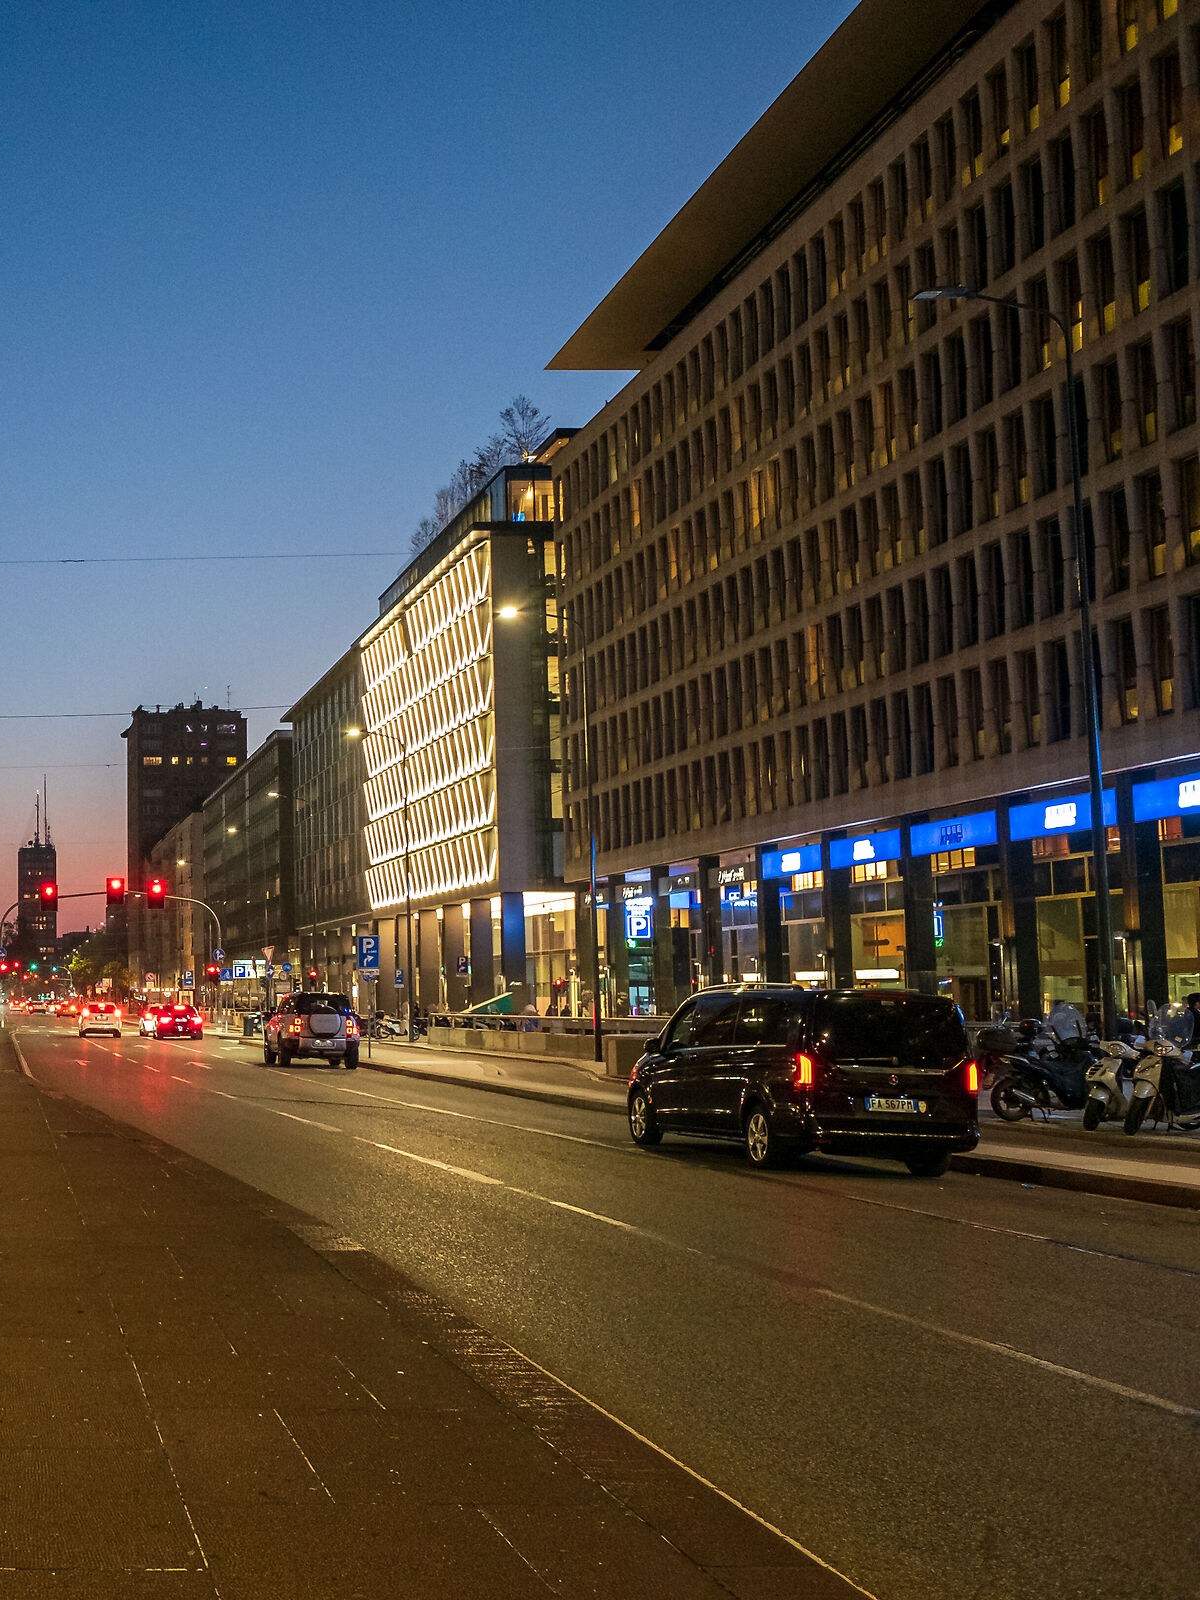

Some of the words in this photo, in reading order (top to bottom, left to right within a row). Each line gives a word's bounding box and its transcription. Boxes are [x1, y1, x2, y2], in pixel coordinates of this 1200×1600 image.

[631, 917, 647, 936] P
[362, 938, 375, 954] P
[458, 956, 466, 965] P
[185, 971, 192, 980] P
[235, 966, 244, 977] P
[395, 969, 402, 978] P
[871, 1100, 882, 1109] FA
